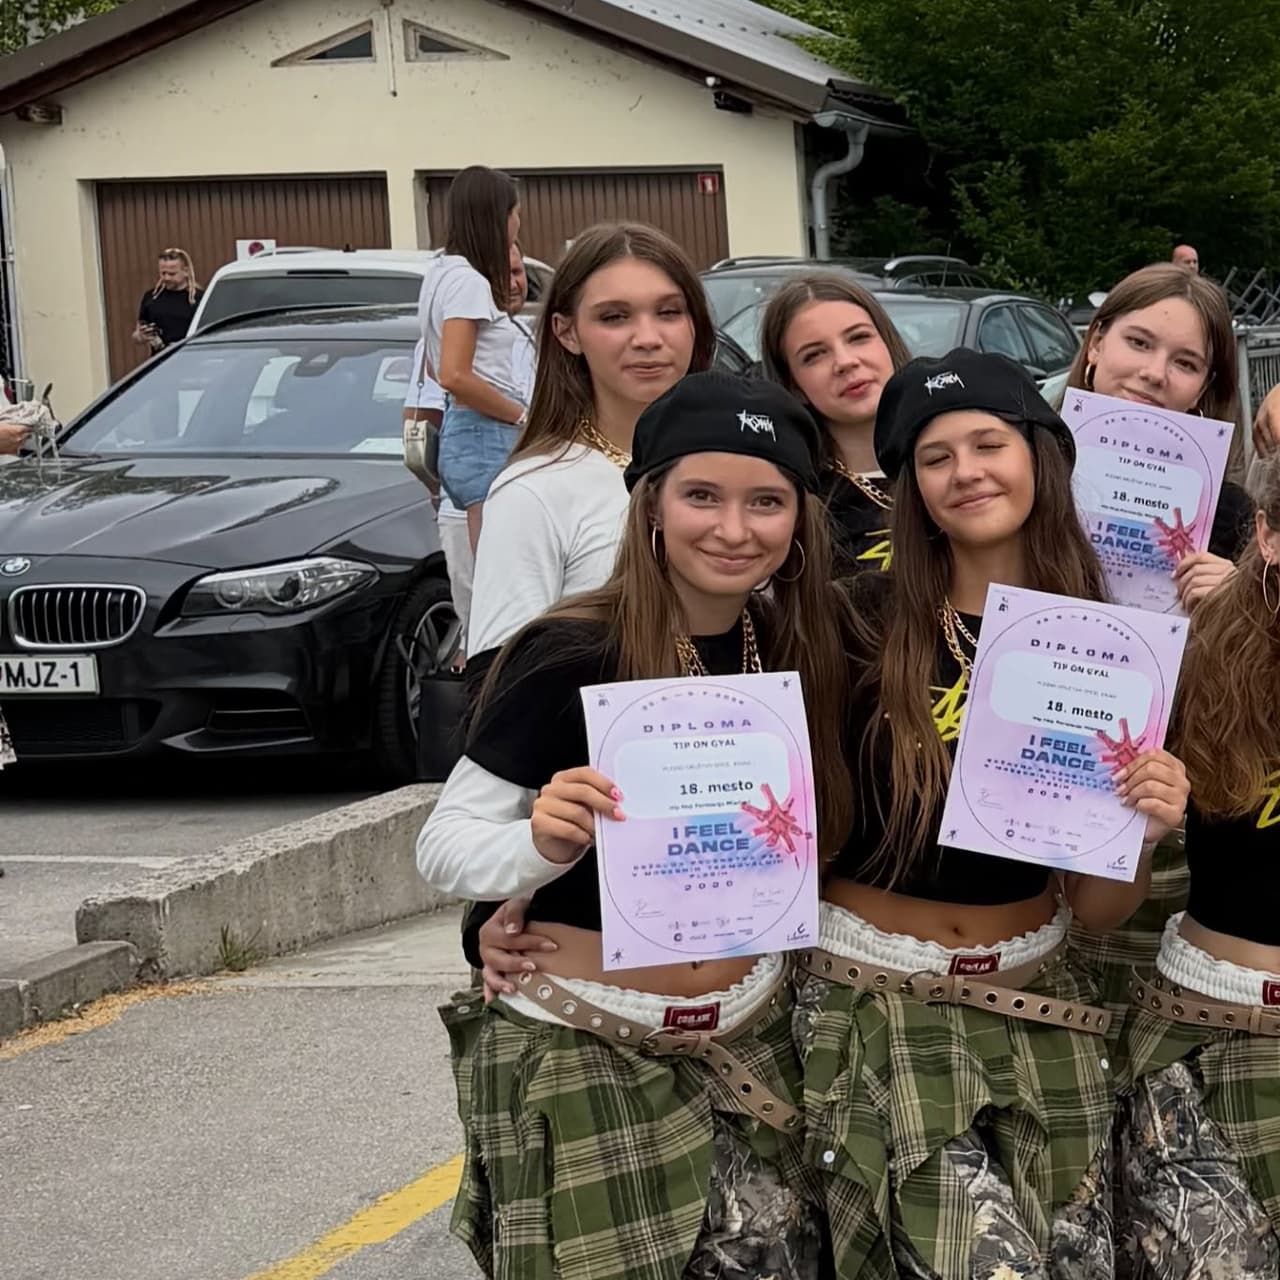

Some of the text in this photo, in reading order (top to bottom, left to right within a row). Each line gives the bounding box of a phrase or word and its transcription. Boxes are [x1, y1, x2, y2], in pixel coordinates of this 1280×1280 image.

[1100, 435, 1184, 461] DIPLOMA
[1112, 490, 1169, 510] 18. mesto
[1105, 523, 1151, 540] FEEL
[1090, 532, 1154, 555] DANCE
[1030, 638, 1130, 663] DIPLOMA
[1047, 700, 1114, 722] 18. mesto
[643, 719, 752, 733] DIPLOMA
[1040, 736, 1093, 756] FEEL
[1020, 748, 1097, 772] DANCE
[680, 780, 754, 795] 18. mesto
[684, 822, 742, 838] FEEL
[668, 838, 750, 856] DANCE
